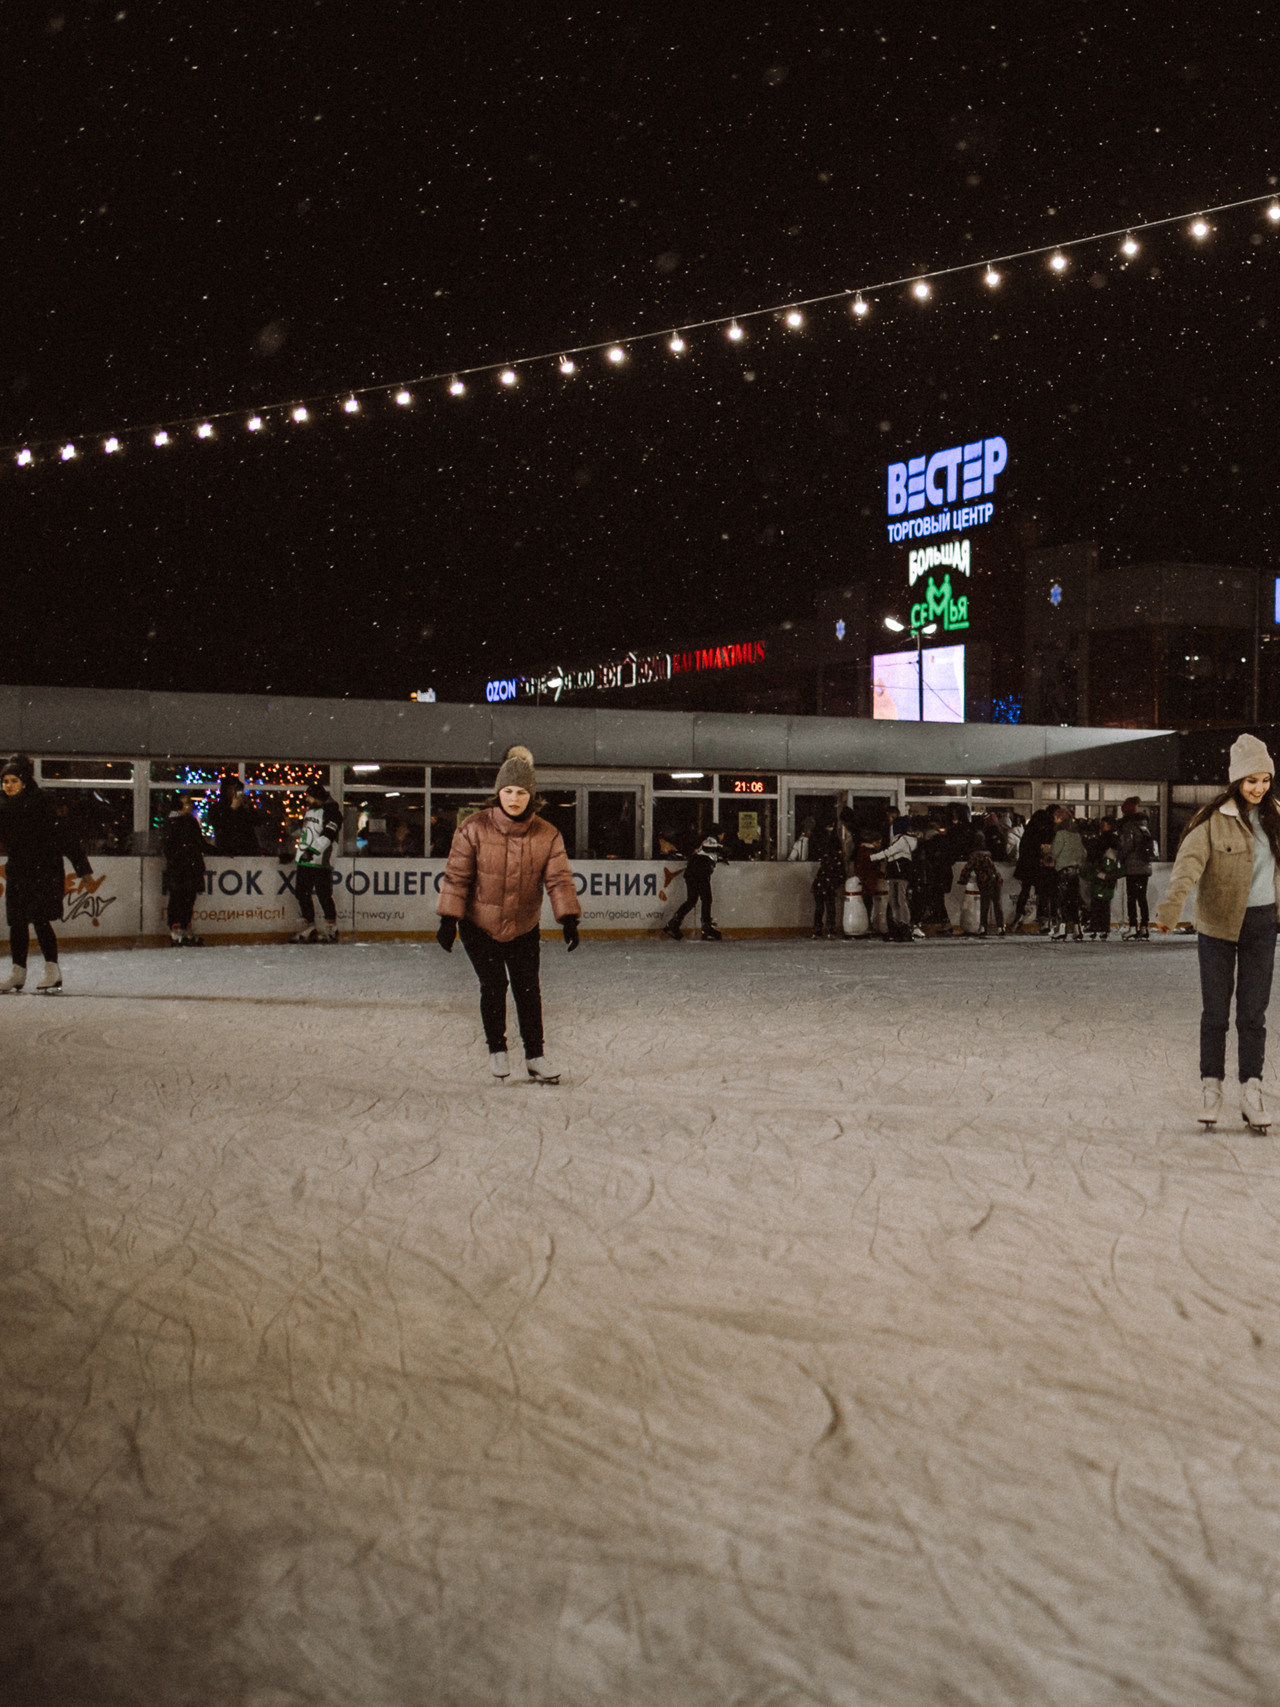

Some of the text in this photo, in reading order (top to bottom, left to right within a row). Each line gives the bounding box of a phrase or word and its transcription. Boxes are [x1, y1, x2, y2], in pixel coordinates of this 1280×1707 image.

[887, 436, 1008, 516] ВЕСТЕР
[887, 502, 994, 543] ТОРГОВЫЙ ЦЕНТР
[908, 538, 971, 587] БОЛЬШАЯ
[486, 678, 518, 703] OZON
[734, 781, 764, 793] 21:06
[161, 869, 264, 896] ТОК
